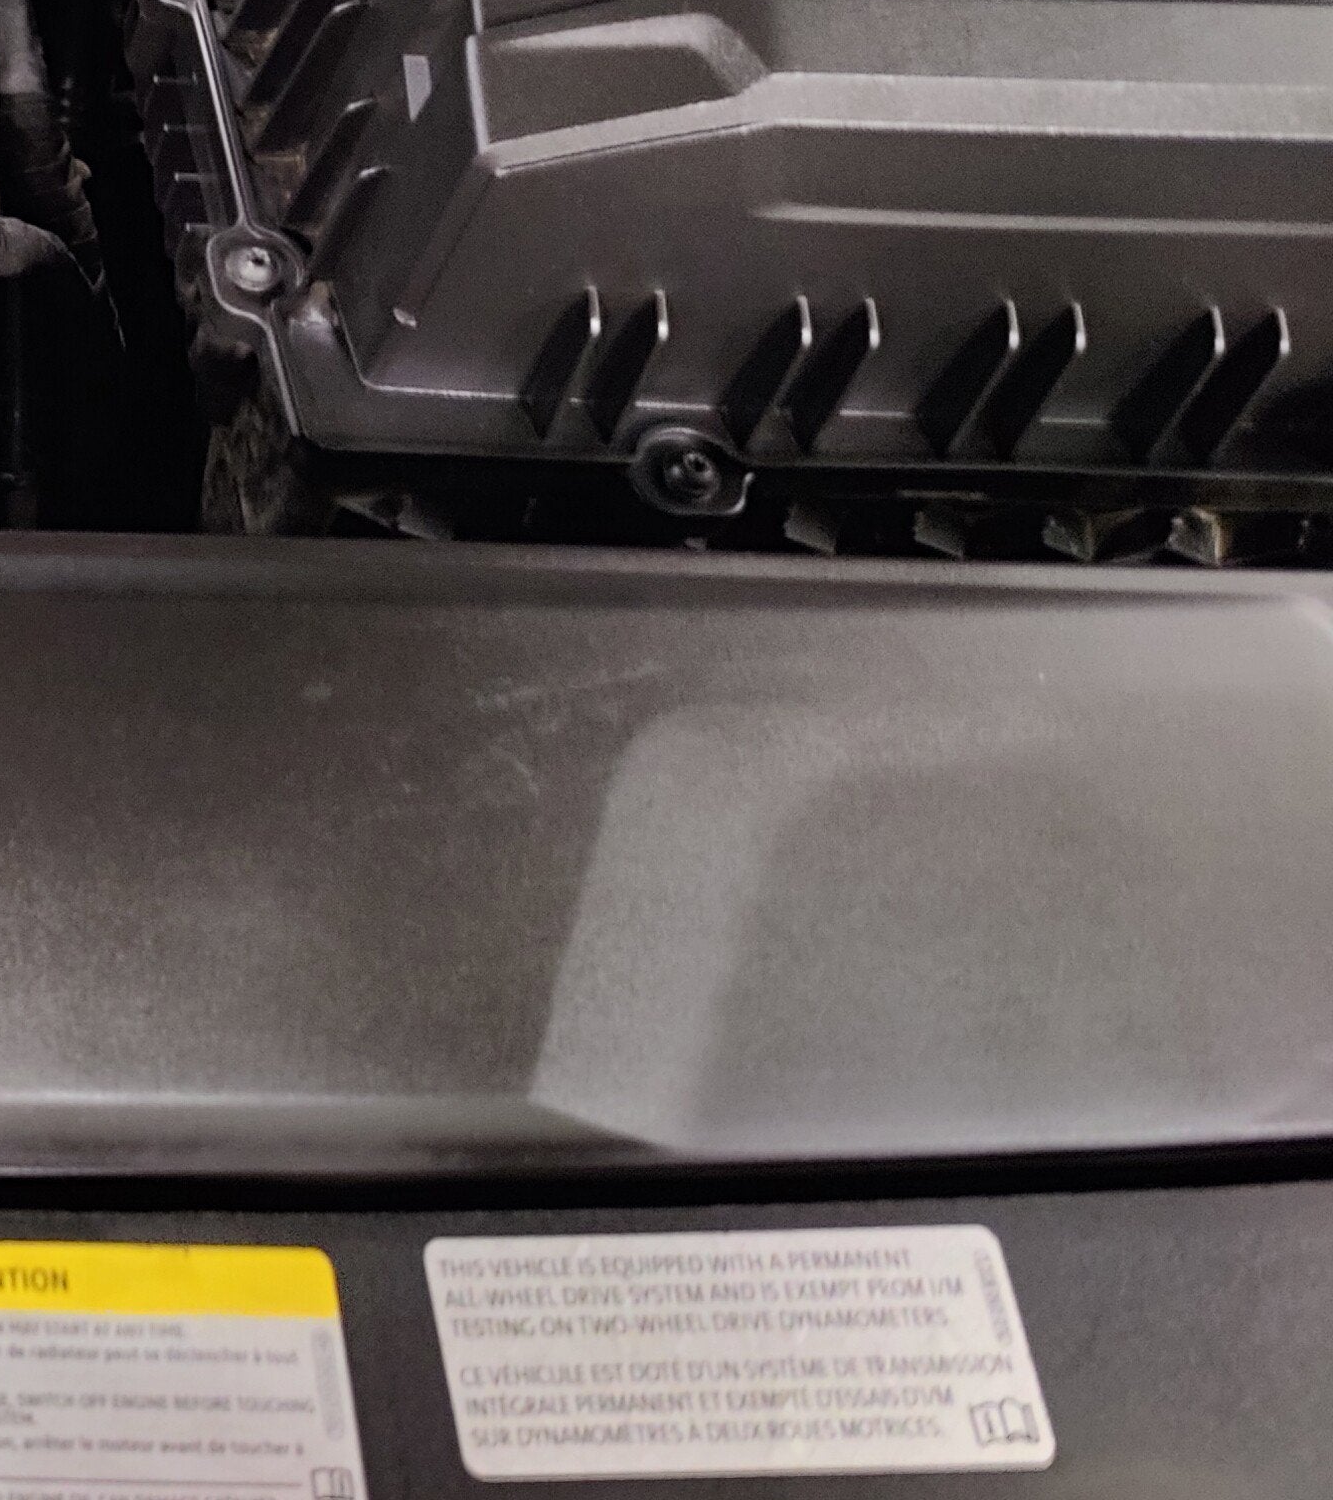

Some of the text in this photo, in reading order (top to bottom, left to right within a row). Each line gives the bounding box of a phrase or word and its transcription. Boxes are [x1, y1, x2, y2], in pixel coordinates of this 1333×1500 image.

[439, 1249, 911, 1278] THIS VEHICLE IS EQUIPPED WITH A PERMANENT
[563, 1286, 625, 1306] DRIVE
[627, 1284, 704, 1304] SYSTEM
[709, 1282, 756, 1302] AND
[761, 1281, 779, 1300] IS
[784, 1278, 860, 1300] EXEMPT
[866, 1278, 925, 1297] FROM
[452, 1316, 536, 1337] TESTING
[540, 1315, 573, 1335] ON
[712, 1311, 775, 1332] DRIVE
[778, 1306, 949, 1331] DYNAMOMETERS
[460, 1365, 486, 1386] CE
[591, 1363, 624, 1383] EST
[833, 1358, 858, 1377] DE
[865, 1353, 1013, 1376] TRANSMISSION
[575, 1390, 694, 1413] PERMANENT
[698, 1390, 721, 1409] ET
[470, 1426, 513, 1448] SUR
[707, 1421, 764, 1443] DEUX
[765, 1419, 837, 1440] ROUES
[839, 1416, 941, 1438] MOTRICES
